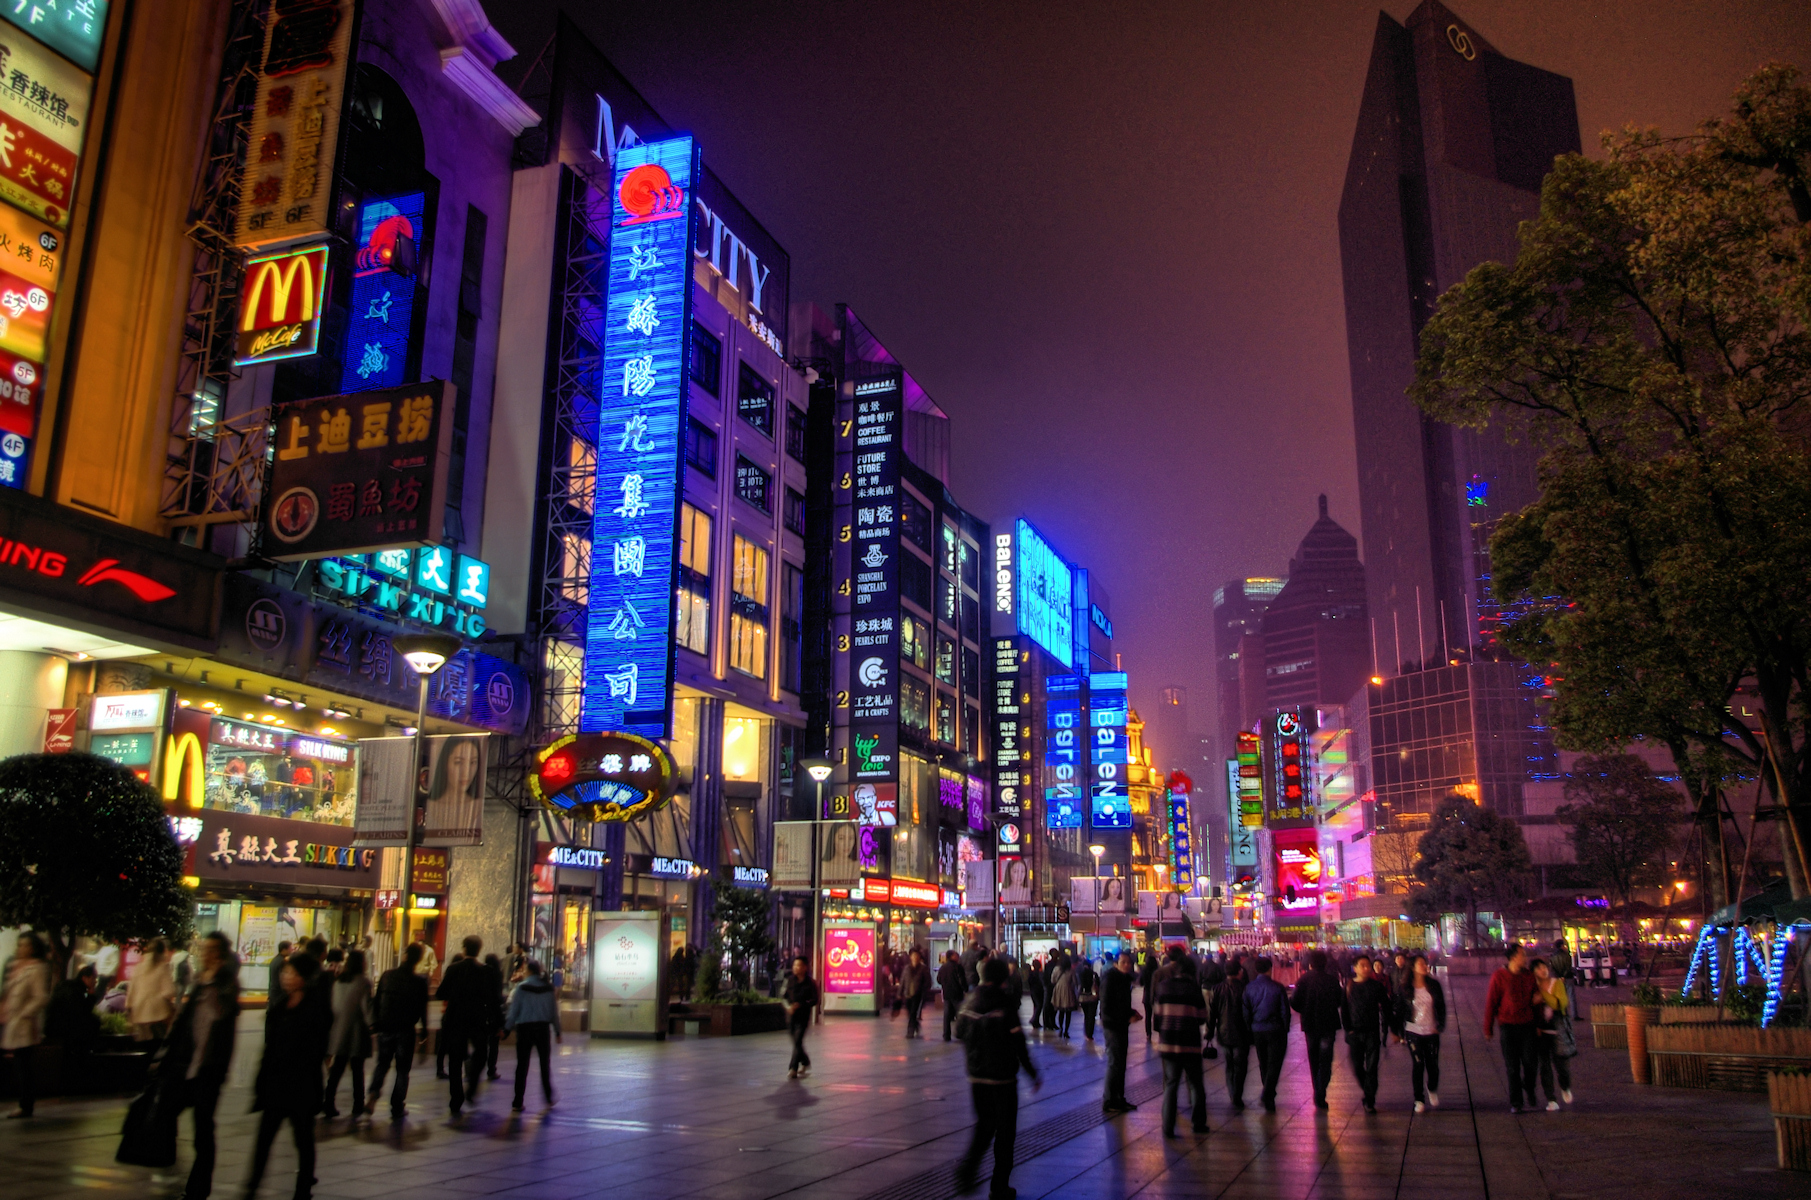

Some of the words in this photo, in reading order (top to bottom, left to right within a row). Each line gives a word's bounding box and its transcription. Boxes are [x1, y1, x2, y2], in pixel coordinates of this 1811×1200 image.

[9, 68, 69, 120] 香辣馆
[0, 84, 65, 129] ESTAURANT
[18, 163, 64, 200] 火锅
[285, 205, 310, 224] 6F
[40, 234, 57, 250] 6F
[29, 292, 46, 306] 6F
[17, 366, 33, 379] 5F
[858, 401, 880, 413] 观景
[857, 411, 894, 426] 咖啡餐厅
[840, 419, 853, 437] 7
[857, 425, 886, 438] COFFEE
[4, 439, 23, 452] 4F
[857, 433, 893, 447] RESTAURANT
[857, 451, 886, 465] FUTURE
[857, 462, 882, 475] STORE
[840, 472, 853, 489] 6
[857, 475, 880, 487] 世博
[857, 485, 894, 498] 未来商店
[858, 505, 894, 526] 陶瓷
[839, 524, 852, 543] 5
[858, 527, 891, 540] 精品商场
[0, 536, 68, 578] ING
[857, 571, 884, 584] SHANGHAI
[838, 578, 852, 597] 4
[857, 581, 888, 594] PORCELAIN
[857, 594, 872, 605] EXPO
[855, 616, 894, 634] 珍珠城
[837, 634, 851, 653] 3
[854, 635, 875, 647] PEARLS
[875, 634, 890, 646] CITY
[1022, 651, 1030, 662] 7
[836, 690, 850, 709] 2
[854, 694, 893, 708] 工艺礼品
[854, 708, 864, 718] ART
[870, 708, 889, 717] CRAFTS
[299, 739, 322, 757] SILK
[322, 744, 348, 763] KING
[870, 754, 891, 763] EXPO
[1022, 774, 1031, 786] 3
[876, 800, 896, 809] KFC
[1023, 798, 1031, 810] 2
[366, 831, 406, 839] CLARINS
[437, 829, 480, 837] CLARINS
[208, 826, 302, 865] 真絲大王
[305, 843, 339, 865] SILK
[338, 846, 376, 868] KING
[553, 847, 605, 867] ME&CITY
[653, 857, 694, 875] ME&CITY
[734, 866, 768, 883] ME&CITY
[382, 900, 394, 908] 7F
